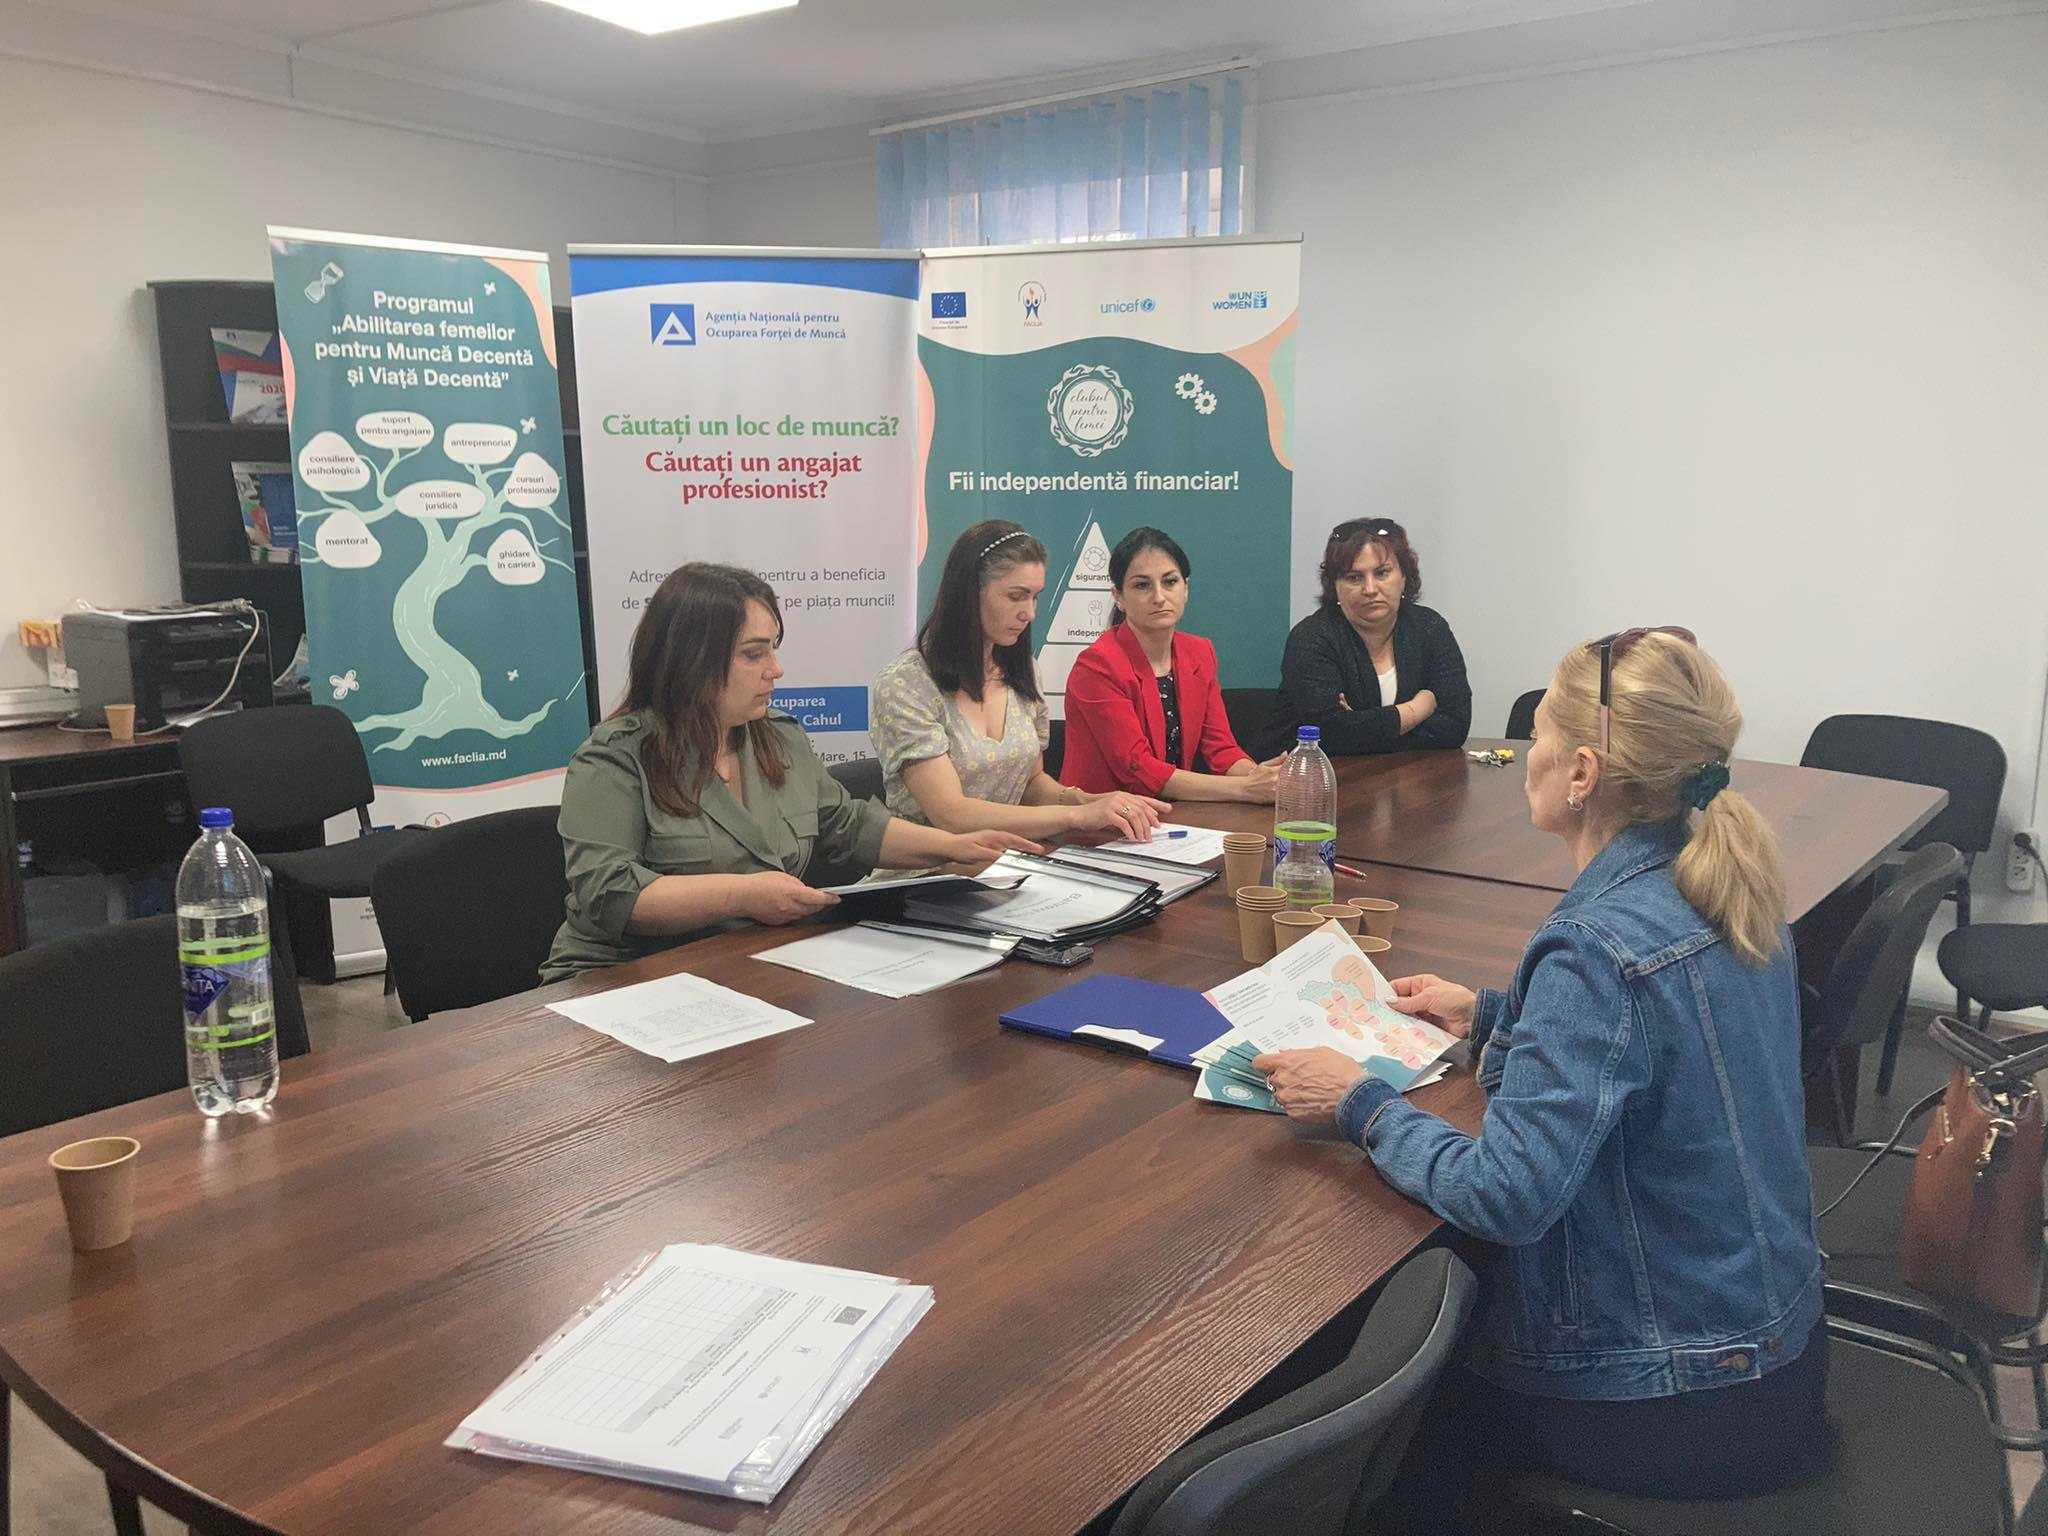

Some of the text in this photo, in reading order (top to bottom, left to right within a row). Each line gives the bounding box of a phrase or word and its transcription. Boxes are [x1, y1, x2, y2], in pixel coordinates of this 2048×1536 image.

[1237, 292, 1252, 300] UN
[373, 291, 474, 314] Programul
[1100, 299, 1140, 314] unicef
[1212, 301, 1252, 310] WOMEN
[705, 311, 840, 325] Agenția Națională pentru
[332, 315, 515, 340] „Abilitarea femeilor
[706, 328, 758, 342] Ocuparea
[794, 328, 807, 340] de
[810, 328, 846, 340] Muncă
[314, 341, 533, 366] pentru Muncă Decentă
[347, 368, 364, 387] și
[368, 367, 418, 389] Viață
[1069, 404, 1107, 420] pentru
[382, 416, 410, 425] suport
[1074, 416, 1106, 432] femei
[361, 426, 432, 436] pentru angajare
[602, 414, 900, 444] Căutați un loc de muncă?
[451, 439, 512, 448] antreprenoriat
[310, 455, 355, 463] consiliere
[646, 452, 862, 478] Căutați un angajat
[306, 466, 361, 476] psihologică
[516, 476, 544, 484] cursuri
[950, 470, 1239, 494] Fii independentă financiar!
[420, 490, 462, 499] consiliere
[508, 486, 558, 496] profesionale
[683, 479, 828, 505] profesionist?
[425, 501, 458, 511] juridică
[325, 537, 369, 546] mentorat
[499, 551, 530, 560] ghidare
[508, 562, 536, 570] carieră
[759, 568, 886, 584] pentru a beneficia
[1076, 573, 1112, 582] siguranț
[622, 598, 640, 610] de
[785, 597, 802, 610] pe
[807, 594, 840, 610] piața
[846, 594, 895, 607] muncii!
[1068, 628, 1104, 637] indepen
[803, 714, 842, 726] Cahul
[422, 750, 506, 767] www.faclia.md
